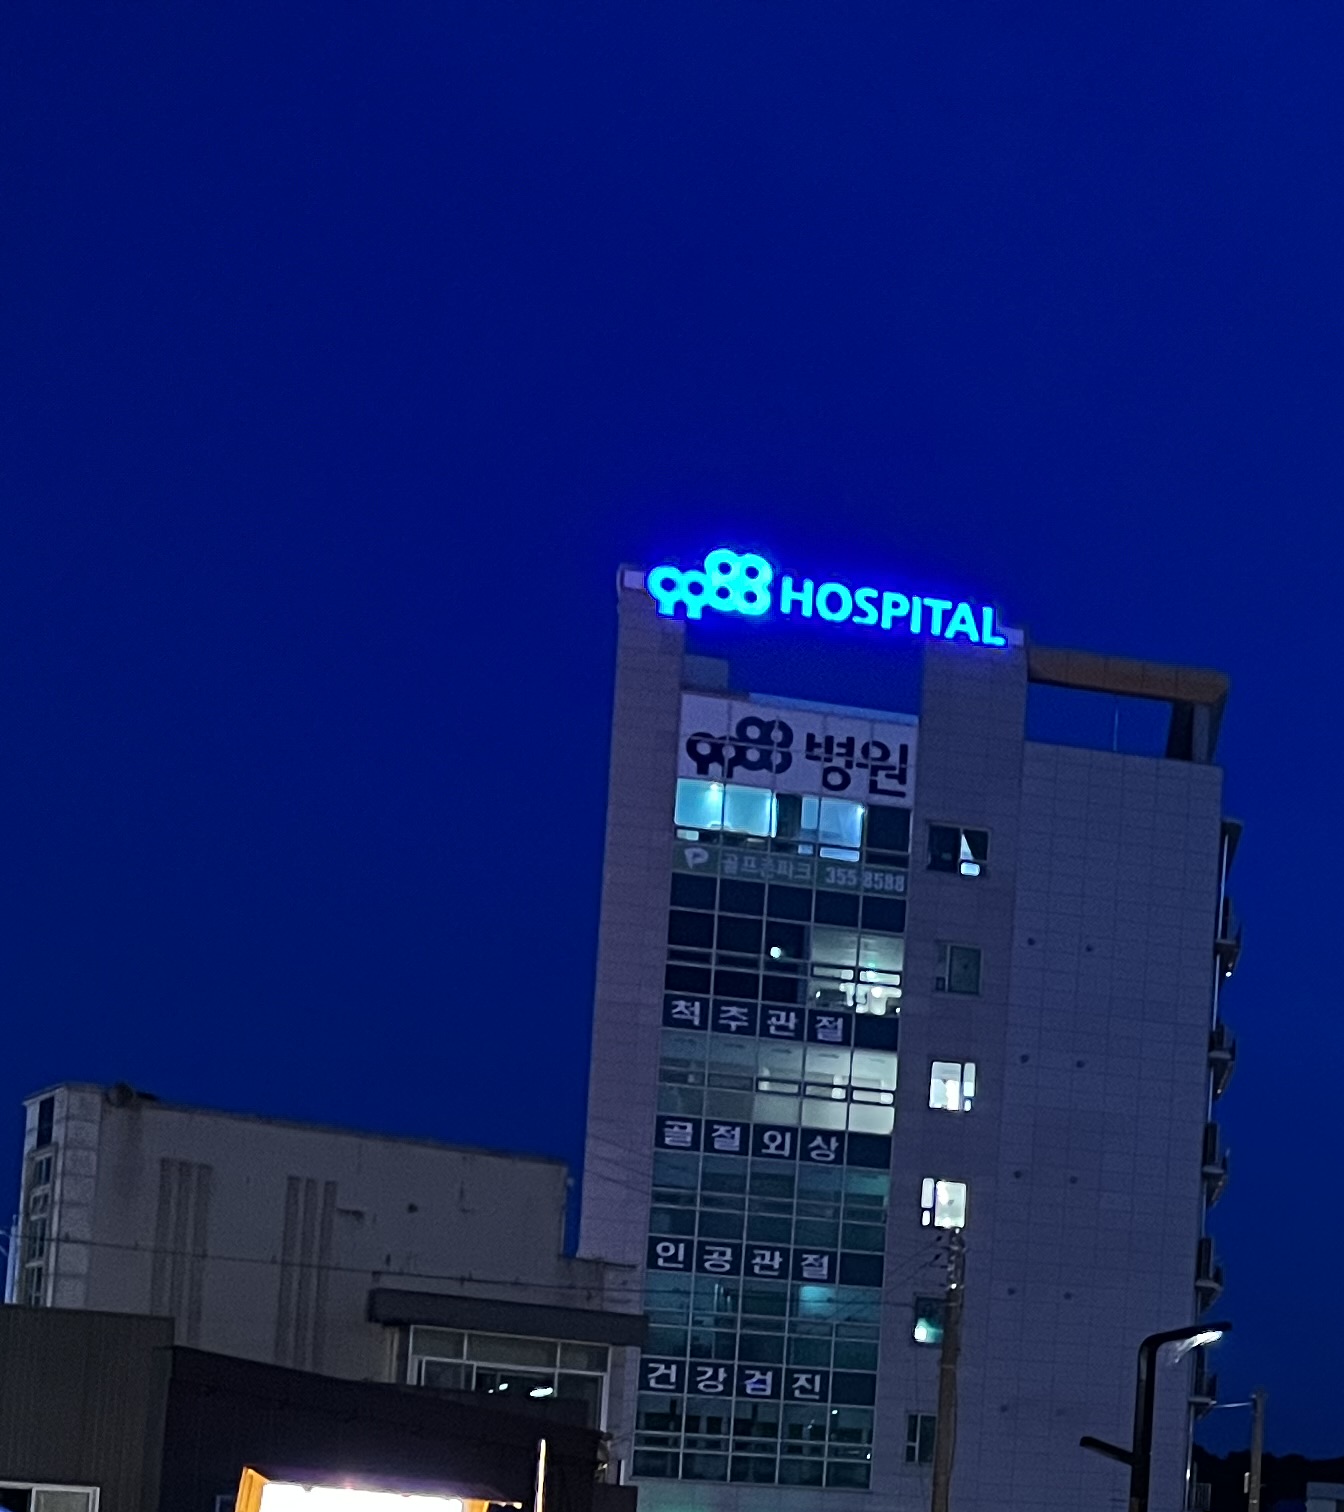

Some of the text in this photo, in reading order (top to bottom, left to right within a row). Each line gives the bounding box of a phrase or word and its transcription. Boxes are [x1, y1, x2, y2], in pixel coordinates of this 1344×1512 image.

[780, 574, 1006, 648] HOSPITAL
[804, 732, 909, 799] 병원
[671, 999, 843, 1043] 척추관절
[663, 1120, 840, 1162] 골절외상
[655, 1241, 829, 1281] 인공관절
[647, 1362, 822, 1400] 건강검진
